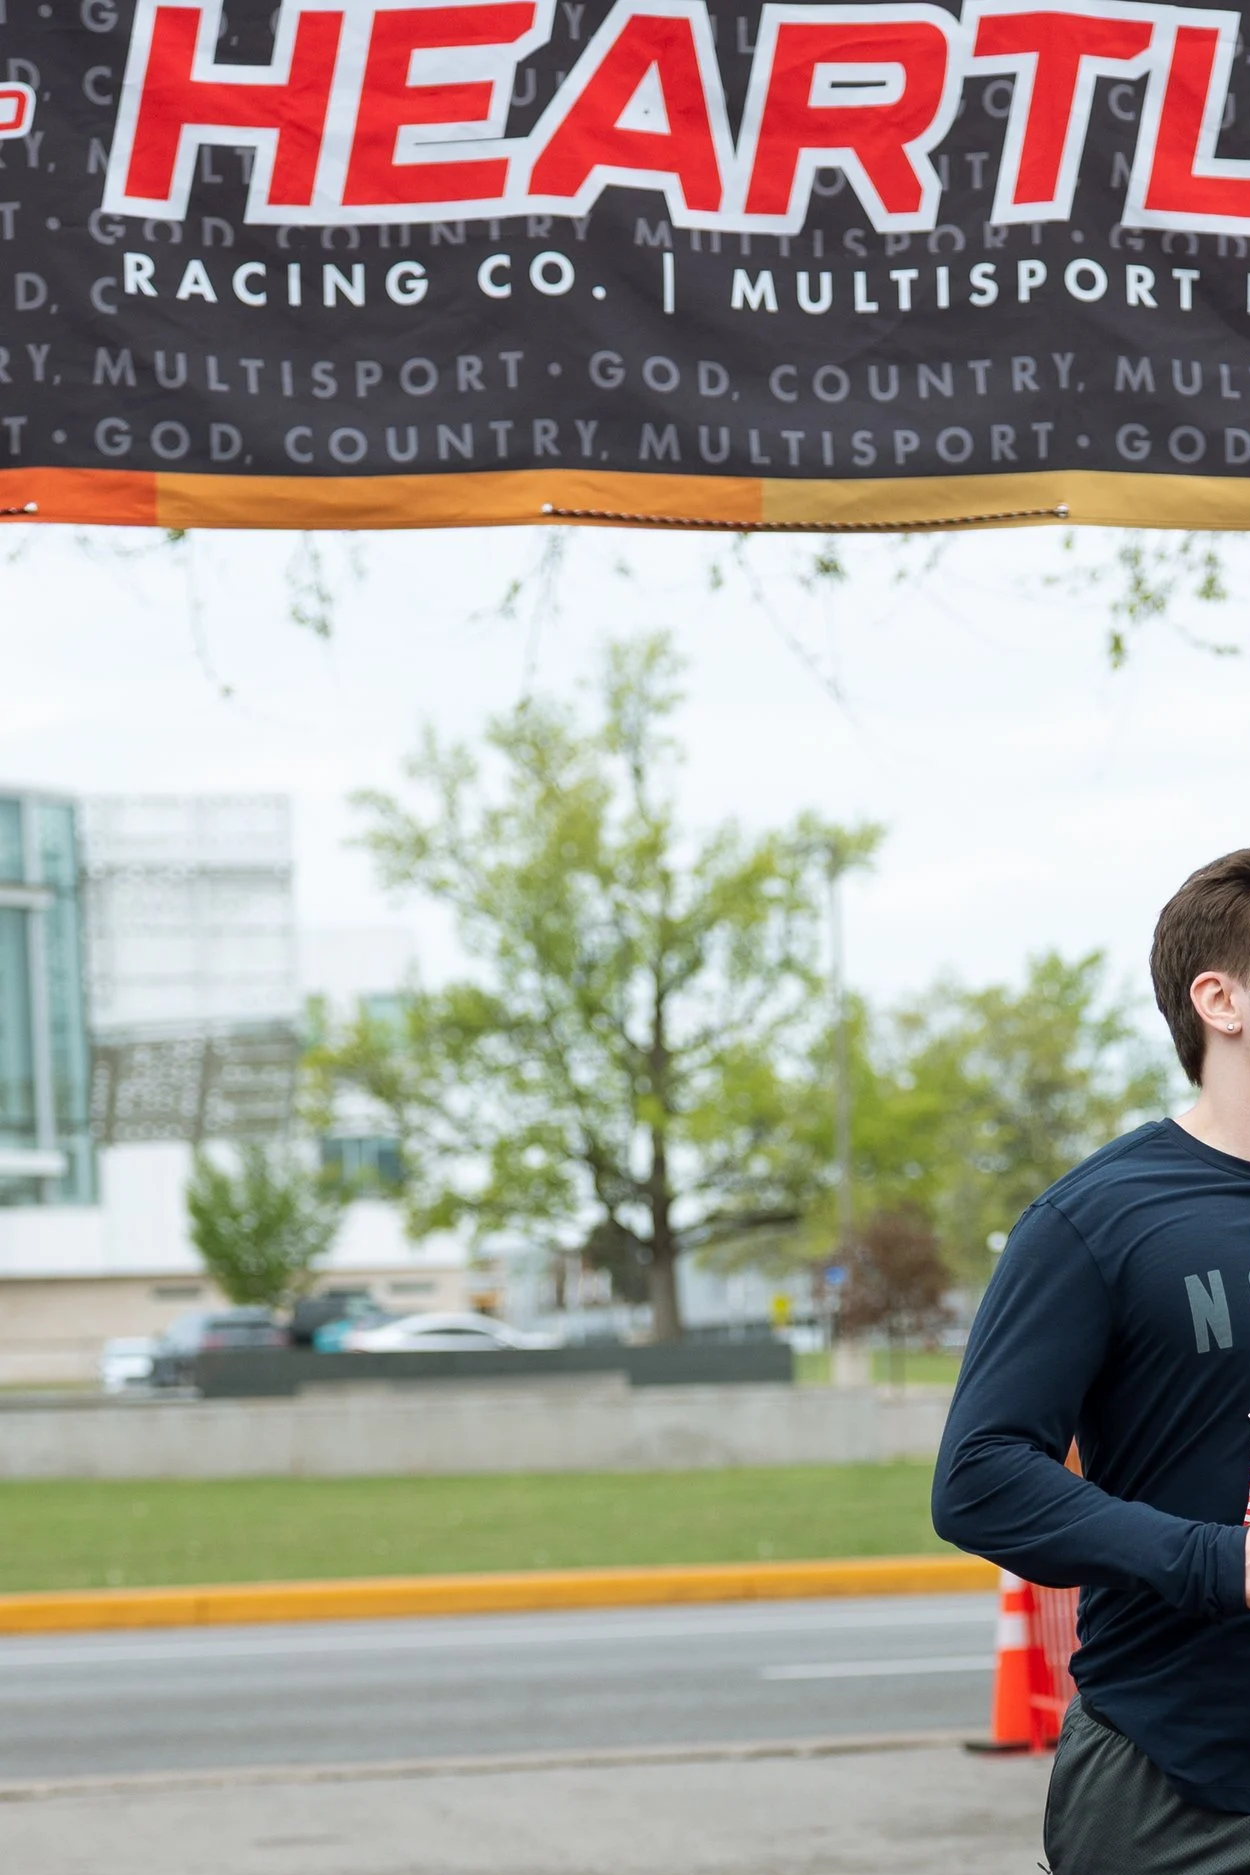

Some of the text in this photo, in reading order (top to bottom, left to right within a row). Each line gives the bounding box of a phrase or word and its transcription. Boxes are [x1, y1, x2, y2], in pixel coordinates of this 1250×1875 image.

[123, 252, 429, 306] RACING
[477, 251, 607, 300] CO.
[731, 258, 1200, 315] MULTISPORT
[92, 346, 524, 399] MULTISPORT
[588, 350, 740, 401] GOD,
[769, 351, 1086, 402] COUNTRY,
[94, 416, 253, 466] GOD,
[283, 418, 609, 463] COUNTRY,
[638, 421, 1055, 468] MULTISPORT
